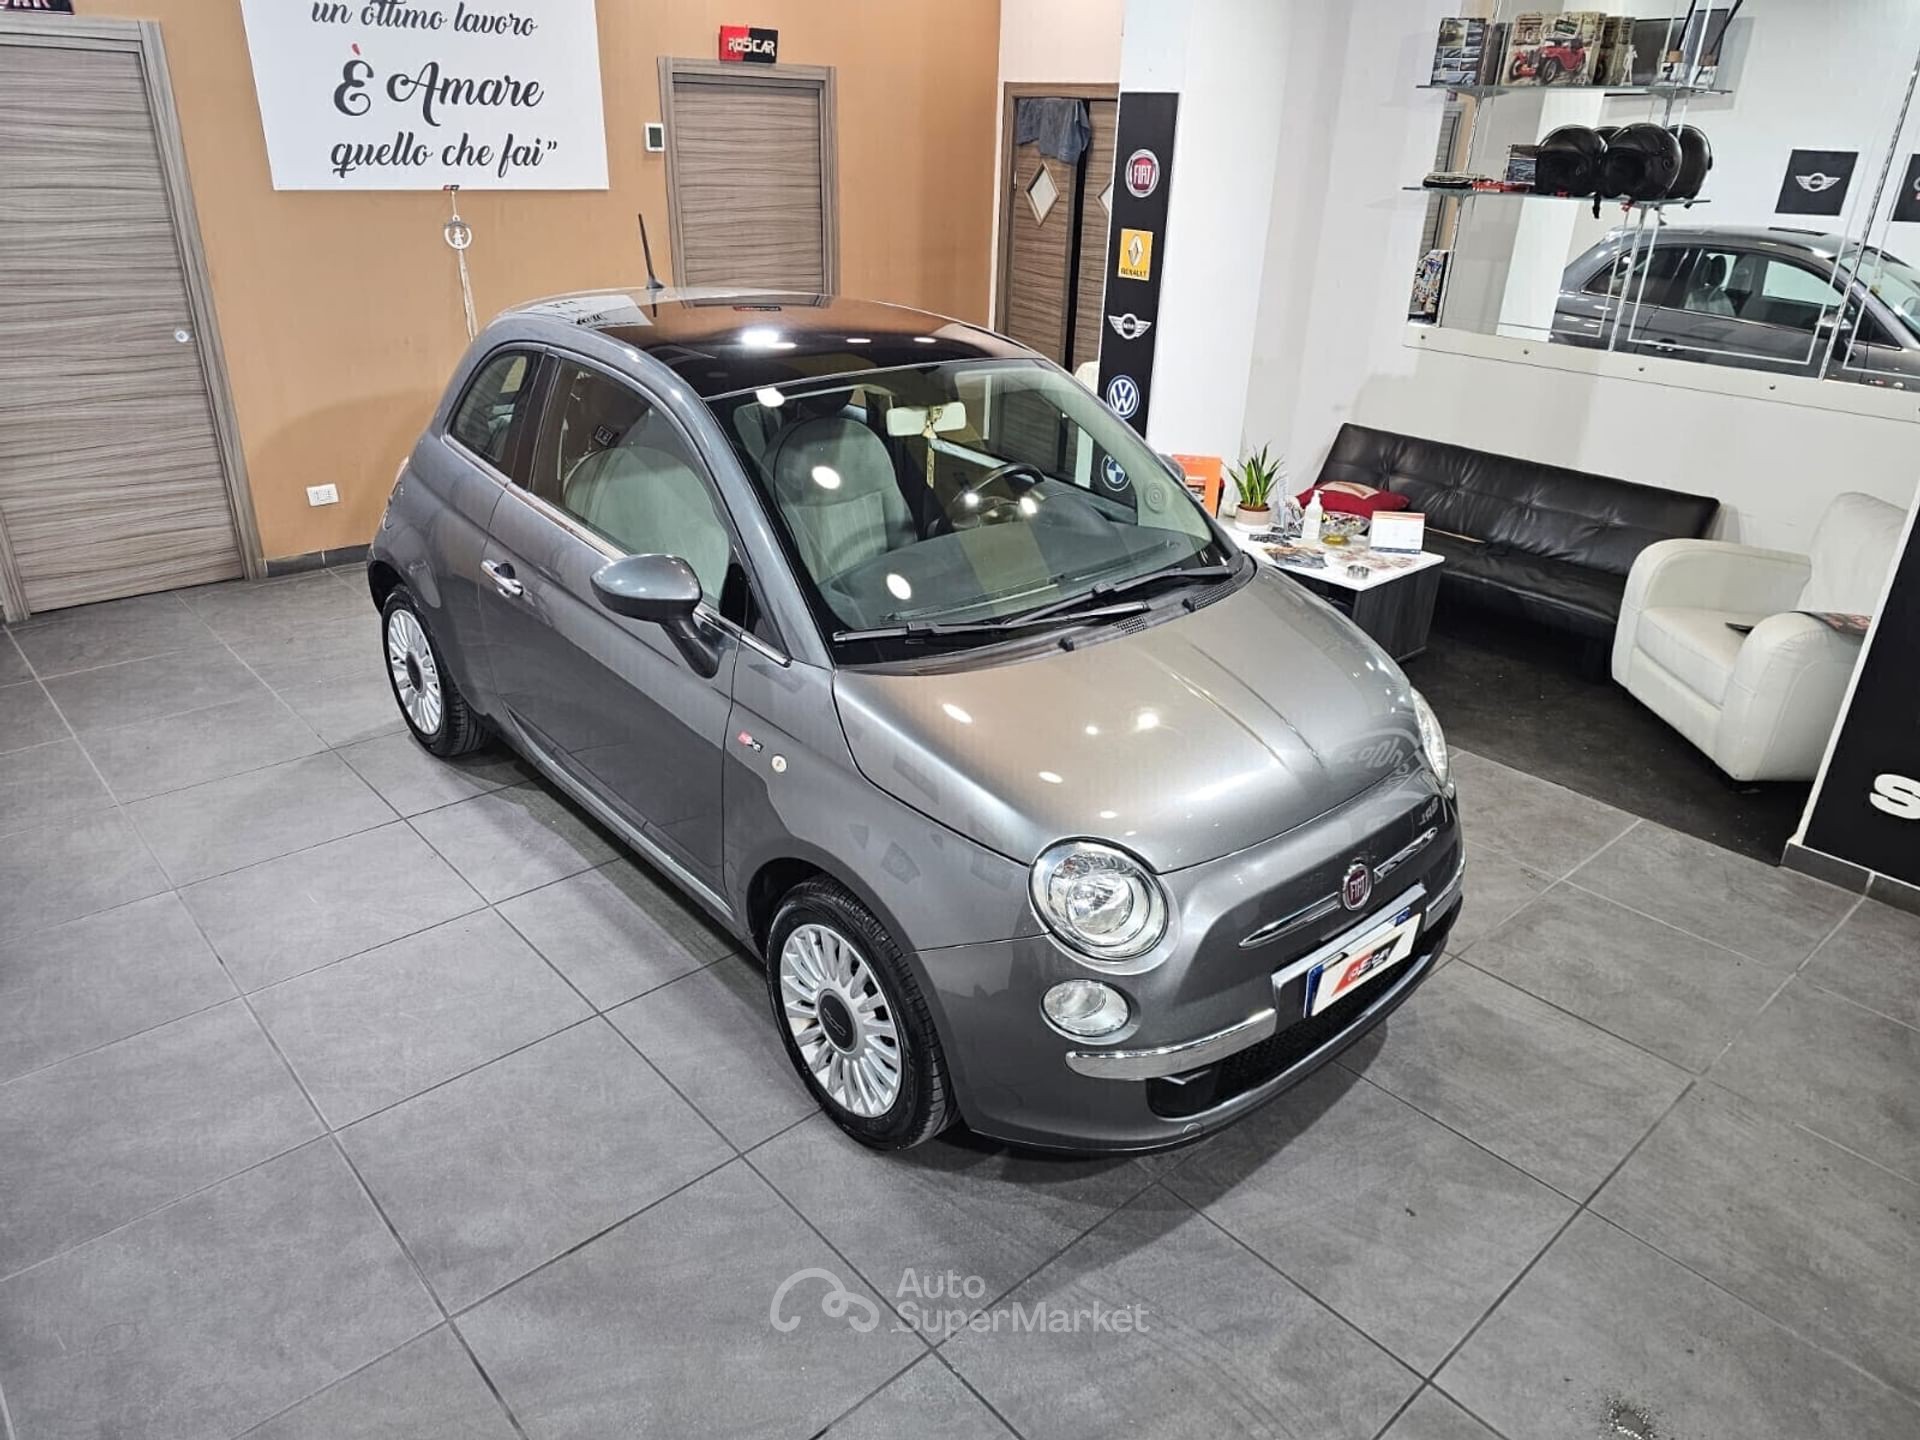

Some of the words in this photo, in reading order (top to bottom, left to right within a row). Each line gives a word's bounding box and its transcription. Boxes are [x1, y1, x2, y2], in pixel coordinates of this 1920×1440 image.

[311, 1, 352, 24] un
[360, 0, 447, 30] ottimo
[453, 1, 538, 36] lavoro
[333, 43, 374, 117] È
[386, 61, 545, 127] Amare
[330, 131, 434, 179] quello
[441, 132, 494, 167] che
[1133, 164, 1152, 185] FIAT
